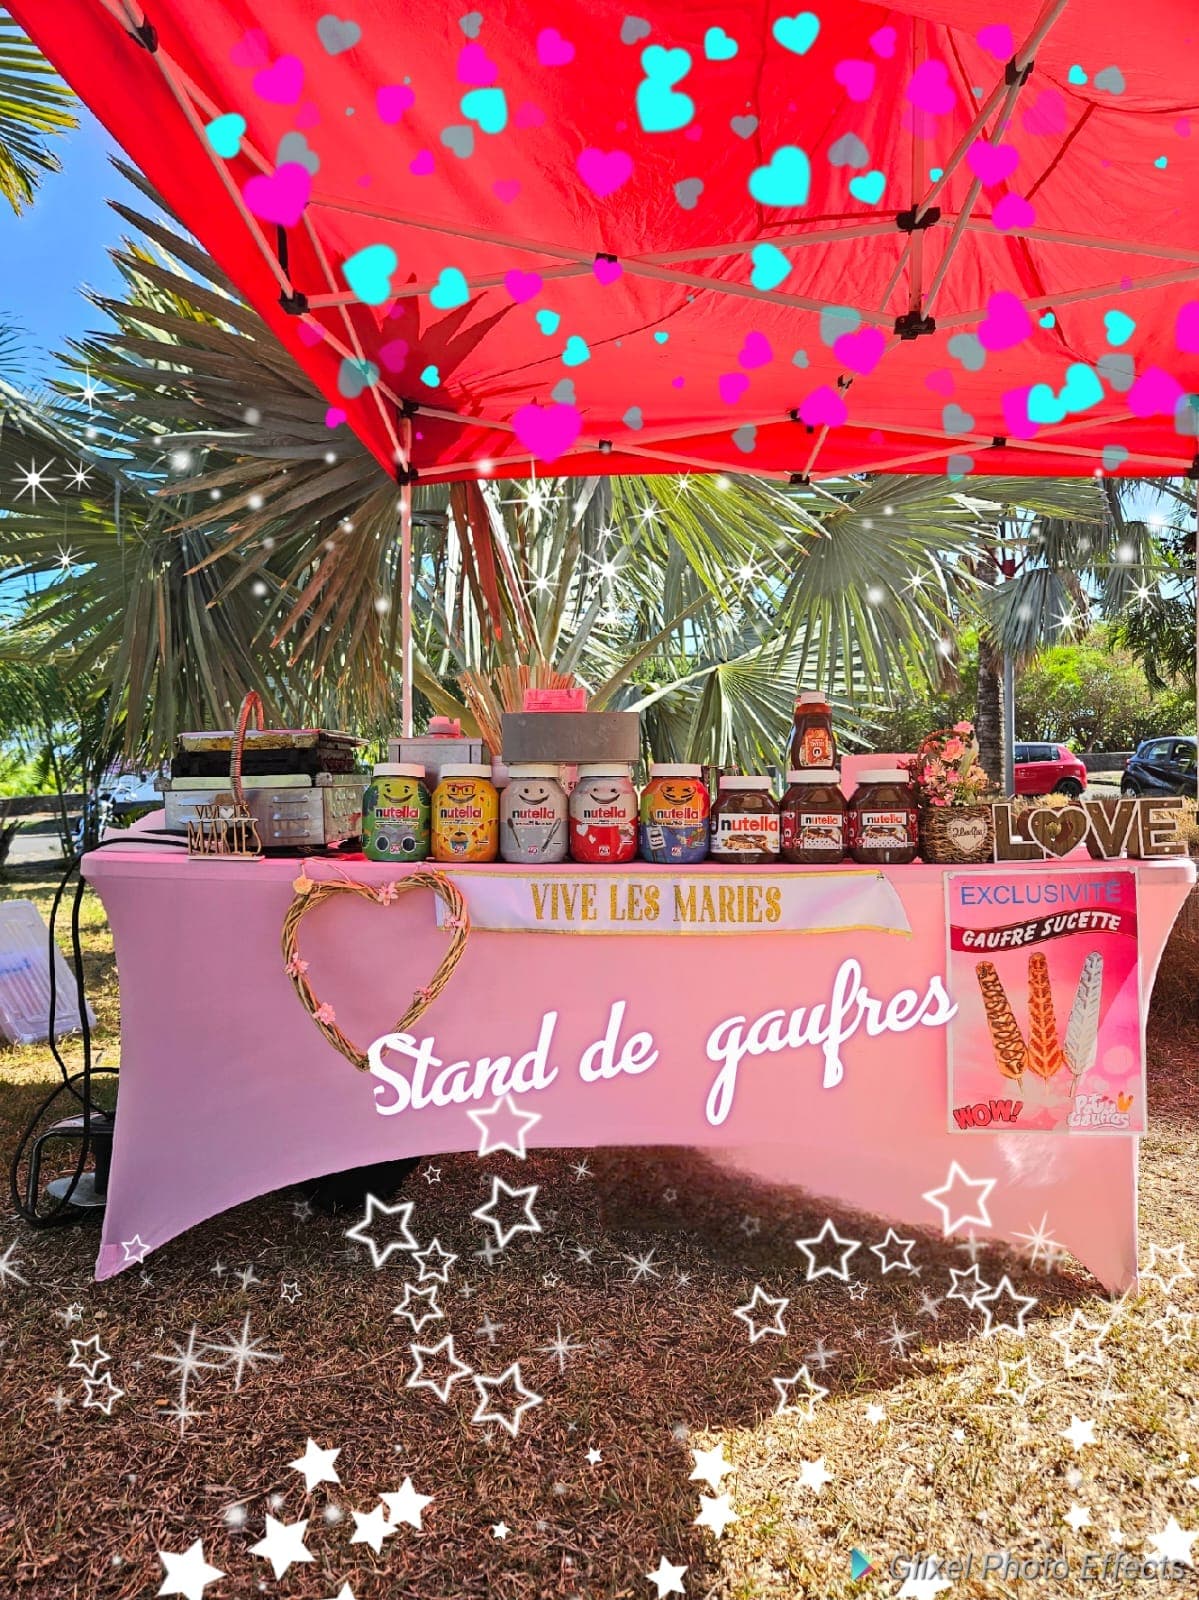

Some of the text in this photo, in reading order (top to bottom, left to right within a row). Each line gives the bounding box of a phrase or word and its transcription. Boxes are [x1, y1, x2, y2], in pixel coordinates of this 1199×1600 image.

[375, 806, 419, 818] nutella
[440, 805, 482, 818] nutella
[512, 807, 555, 819] nutella
[583, 806, 626, 819] nutella
[656, 807, 699, 819] nutella
[721, 816, 778, 831] nutella
[805, 815, 839, 825] nutella
[866, 814, 904, 824] nutella
[960, 881, 1121, 905] EXCLUSIVITÉ
[530, 883, 782, 923] VIVE LES MARIES
[962, 911, 1122, 948] GAUFRE SUCETTE
[953, 1100, 1023, 1129] WOW!
